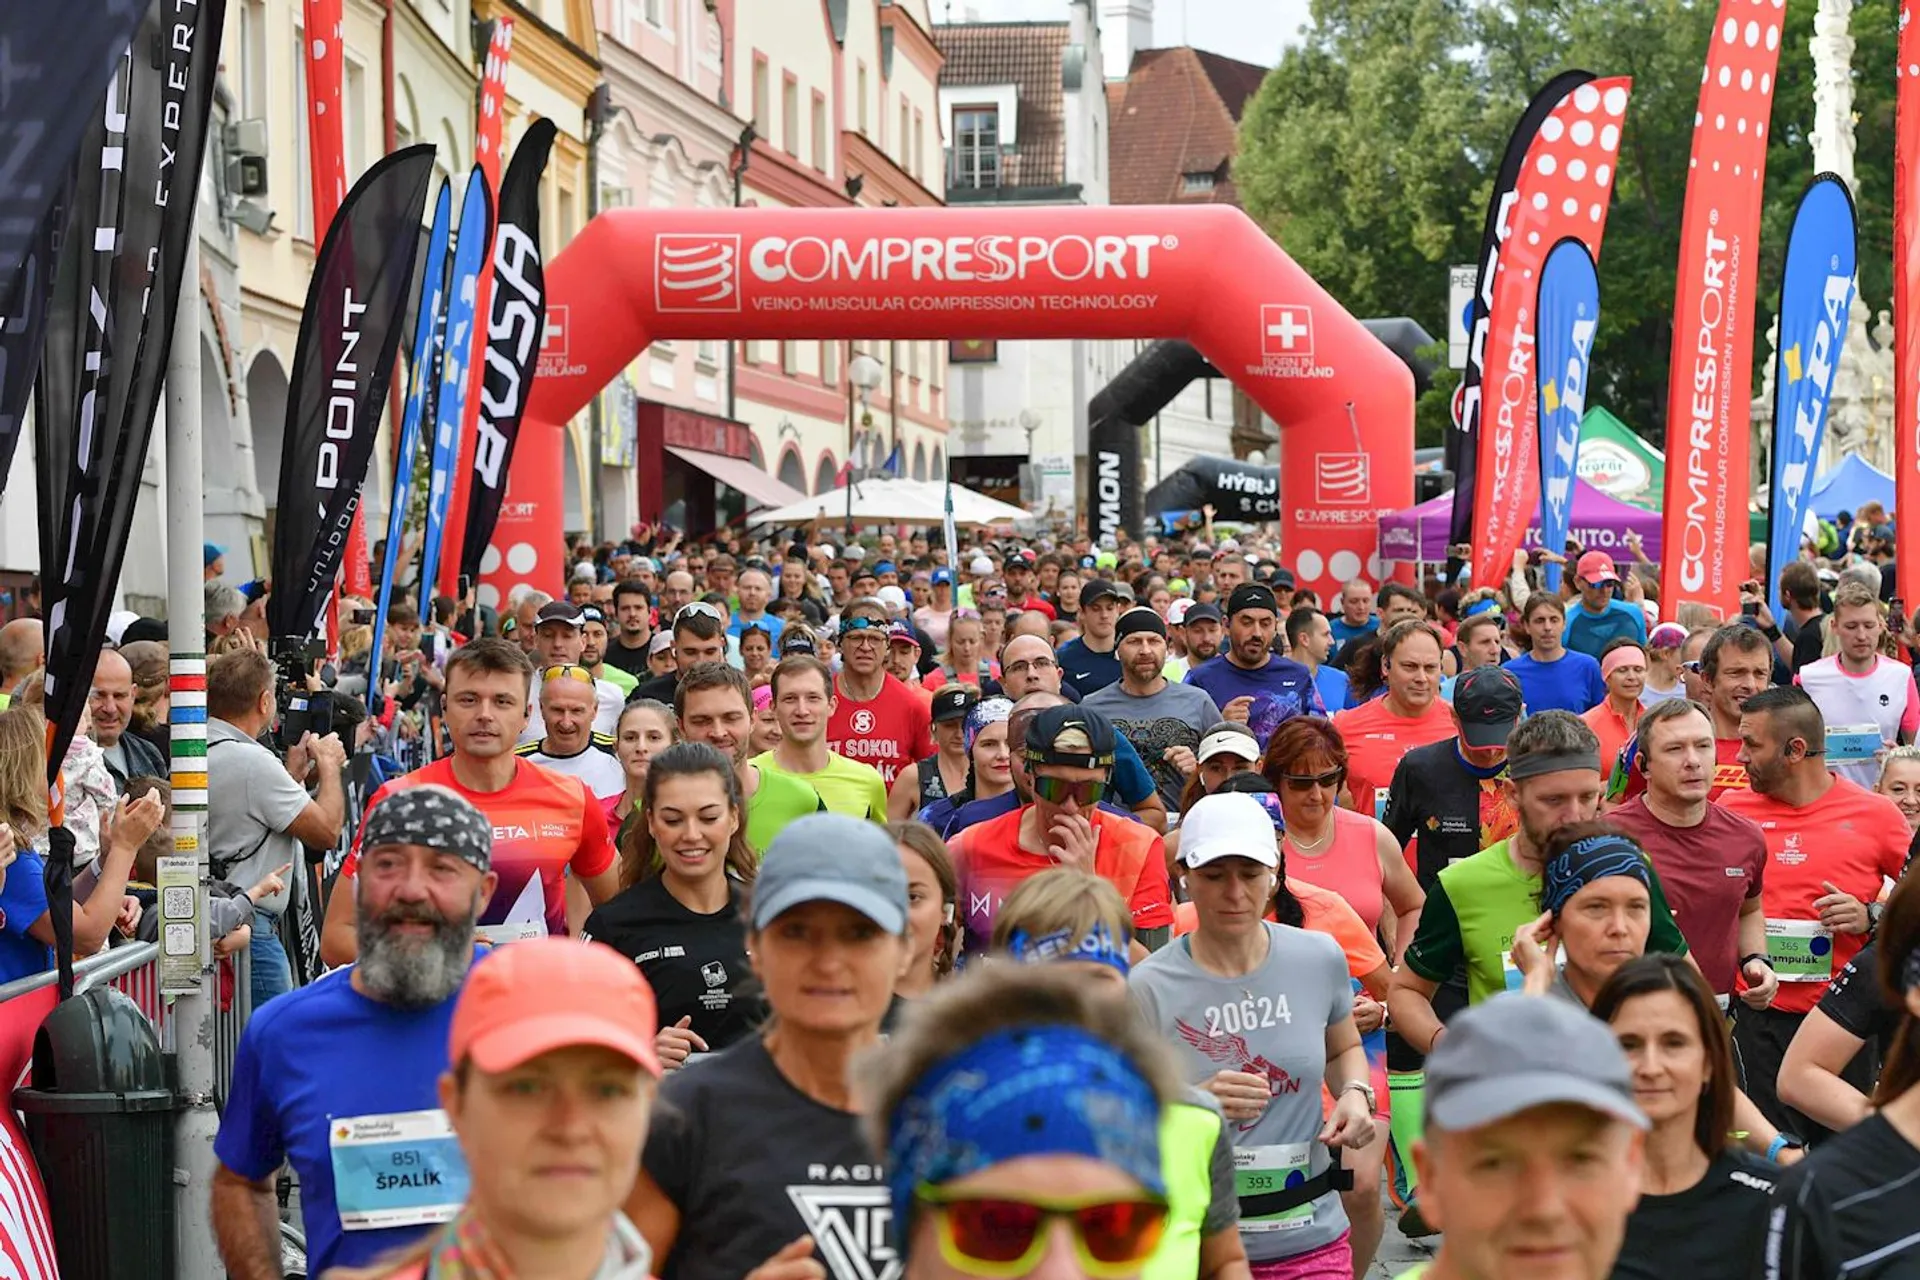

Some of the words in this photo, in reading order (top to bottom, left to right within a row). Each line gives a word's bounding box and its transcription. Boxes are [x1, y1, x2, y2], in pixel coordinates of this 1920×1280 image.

[1725, 234, 1740, 338] TECHNOLOGY
[909, 295, 1036, 312] COMPRESSION
[1040, 294, 1159, 310] TECHNOLOGY
[1246, 365, 1335, 378] SWITZERLAND
[1719, 343, 1733, 456] COMPRESSION
[845, 738, 901, 759] SOKOL
[1204, 993, 1292, 1038] 20624
[391, 1149, 421, 1167] 851
[376, 1167, 442, 1190] ŠPALÍK
[1246, 1176, 1273, 1189] 393
